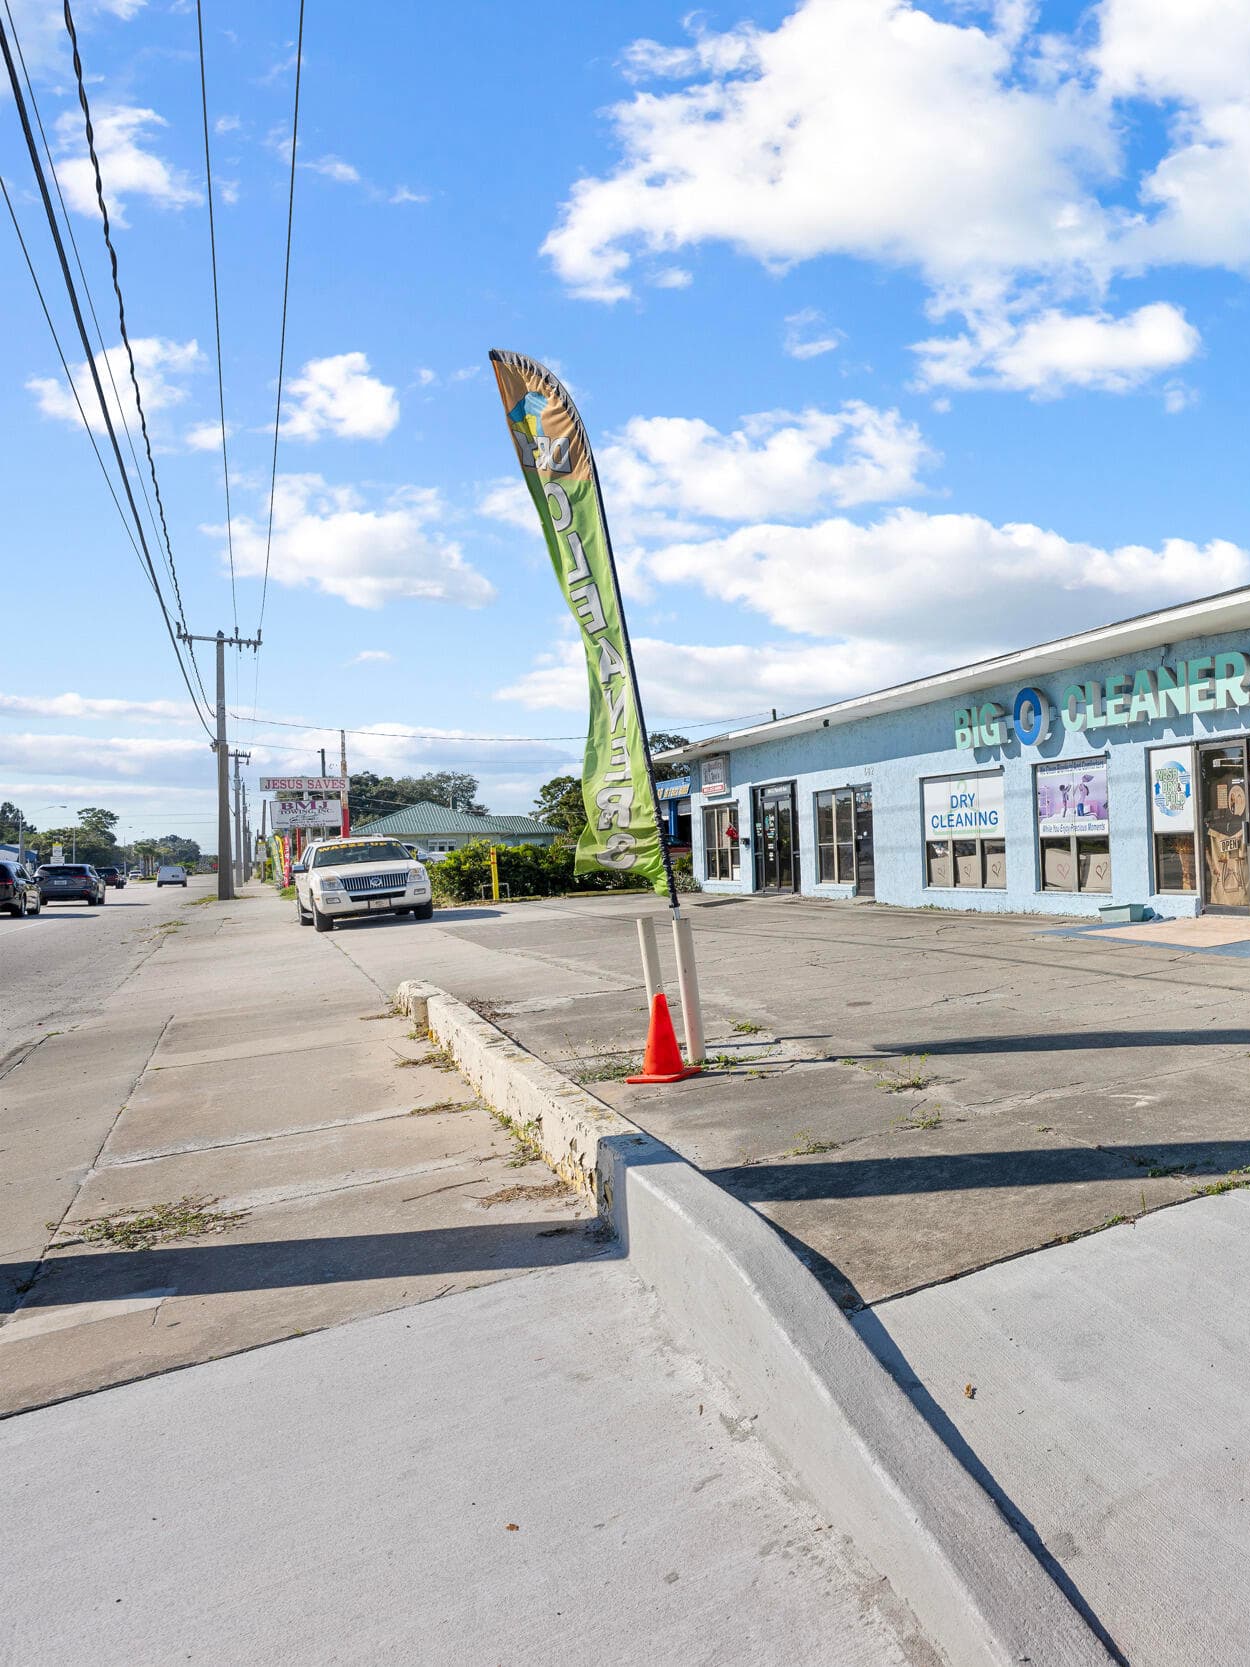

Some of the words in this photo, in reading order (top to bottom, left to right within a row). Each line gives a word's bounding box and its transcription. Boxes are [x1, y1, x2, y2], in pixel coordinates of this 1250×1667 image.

[954, 702, 1006, 750] BIG
[1013, 686, 1048, 747] O
[265, 779, 303, 789] JESUS
[307, 779, 346, 790] SAVES
[281, 800, 328, 811] BMJ
[950, 793, 976, 809] DRY
[931, 810, 999, 829] CLEANING
[1221, 839, 1238, 851] OPEN
